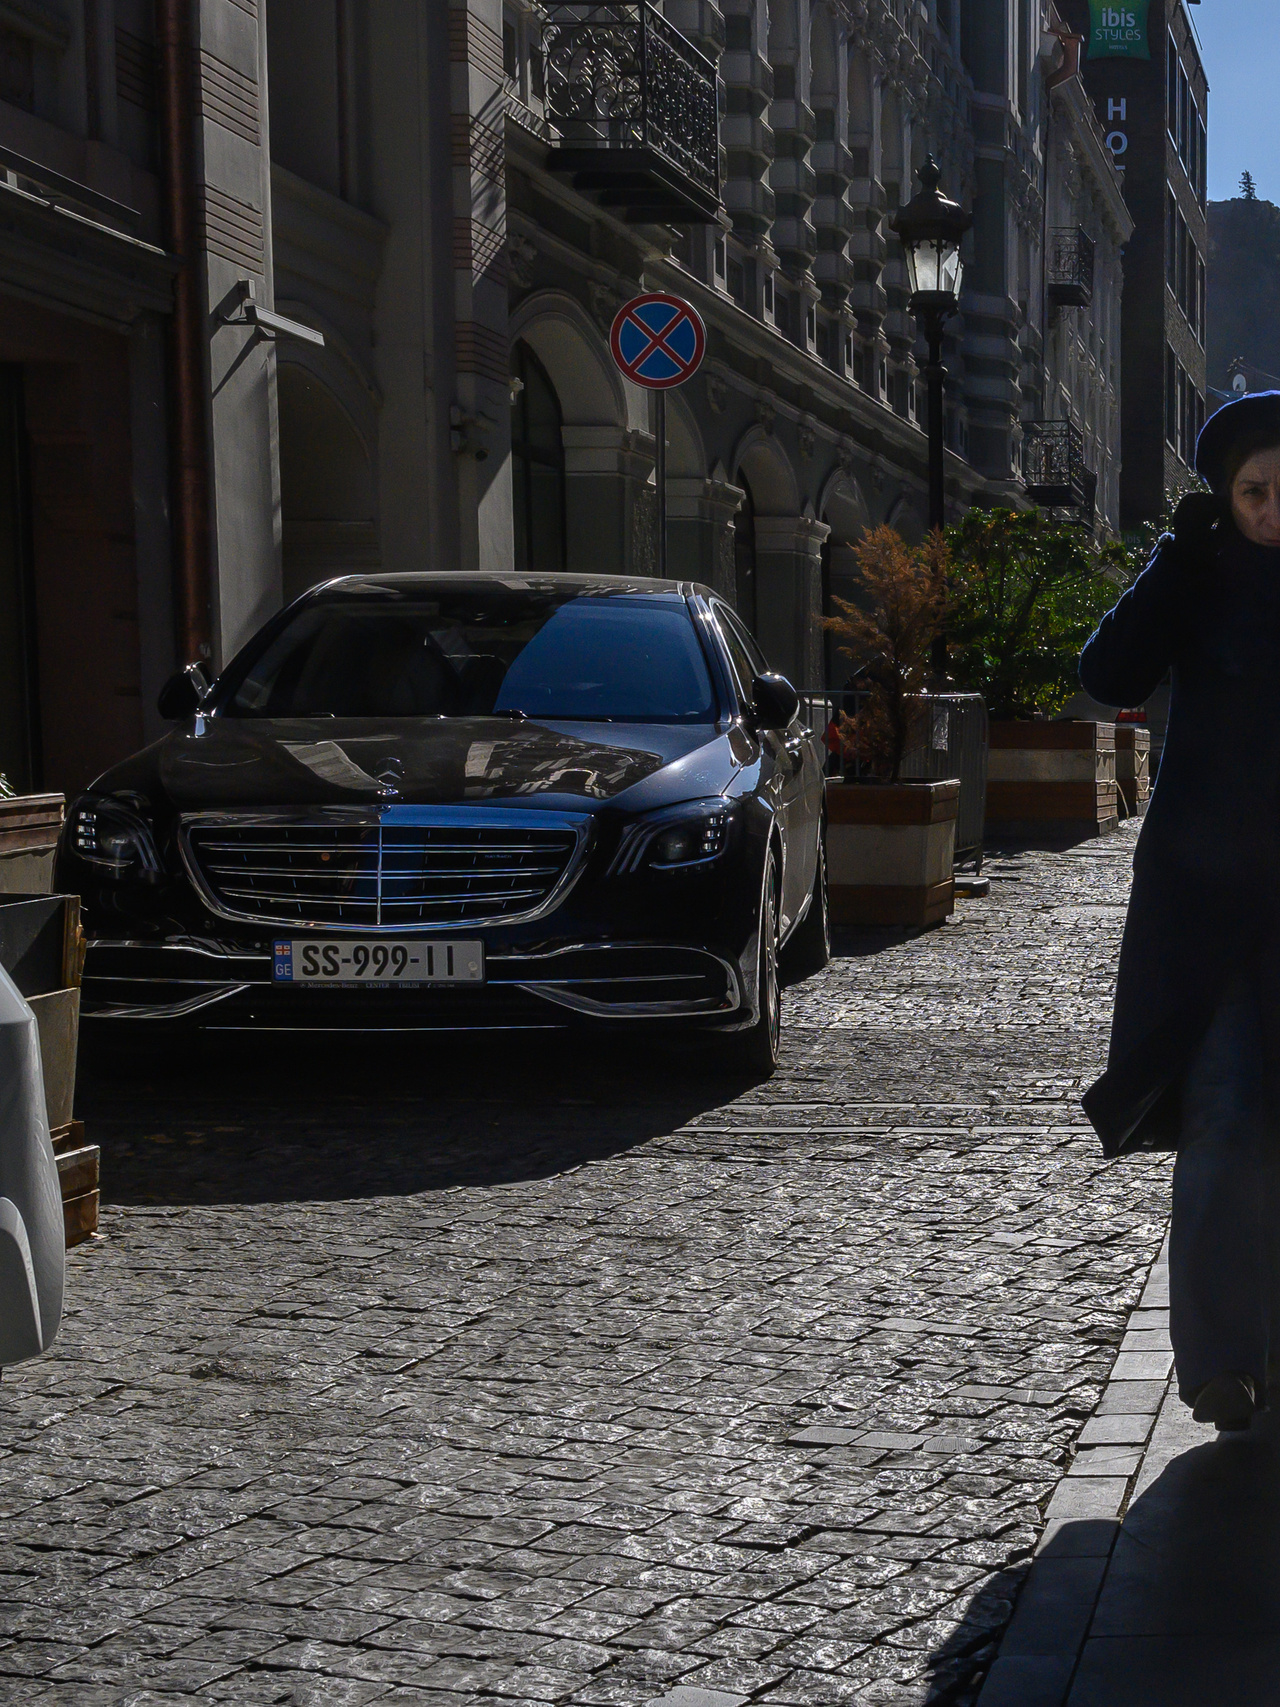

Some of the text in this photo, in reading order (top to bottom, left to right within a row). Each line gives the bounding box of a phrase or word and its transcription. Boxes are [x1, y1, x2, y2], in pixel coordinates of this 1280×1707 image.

[1101, 7, 1136, 27] ibis
[1105, 97, 1129, 171] HO
[275, 964, 292, 976] GE
